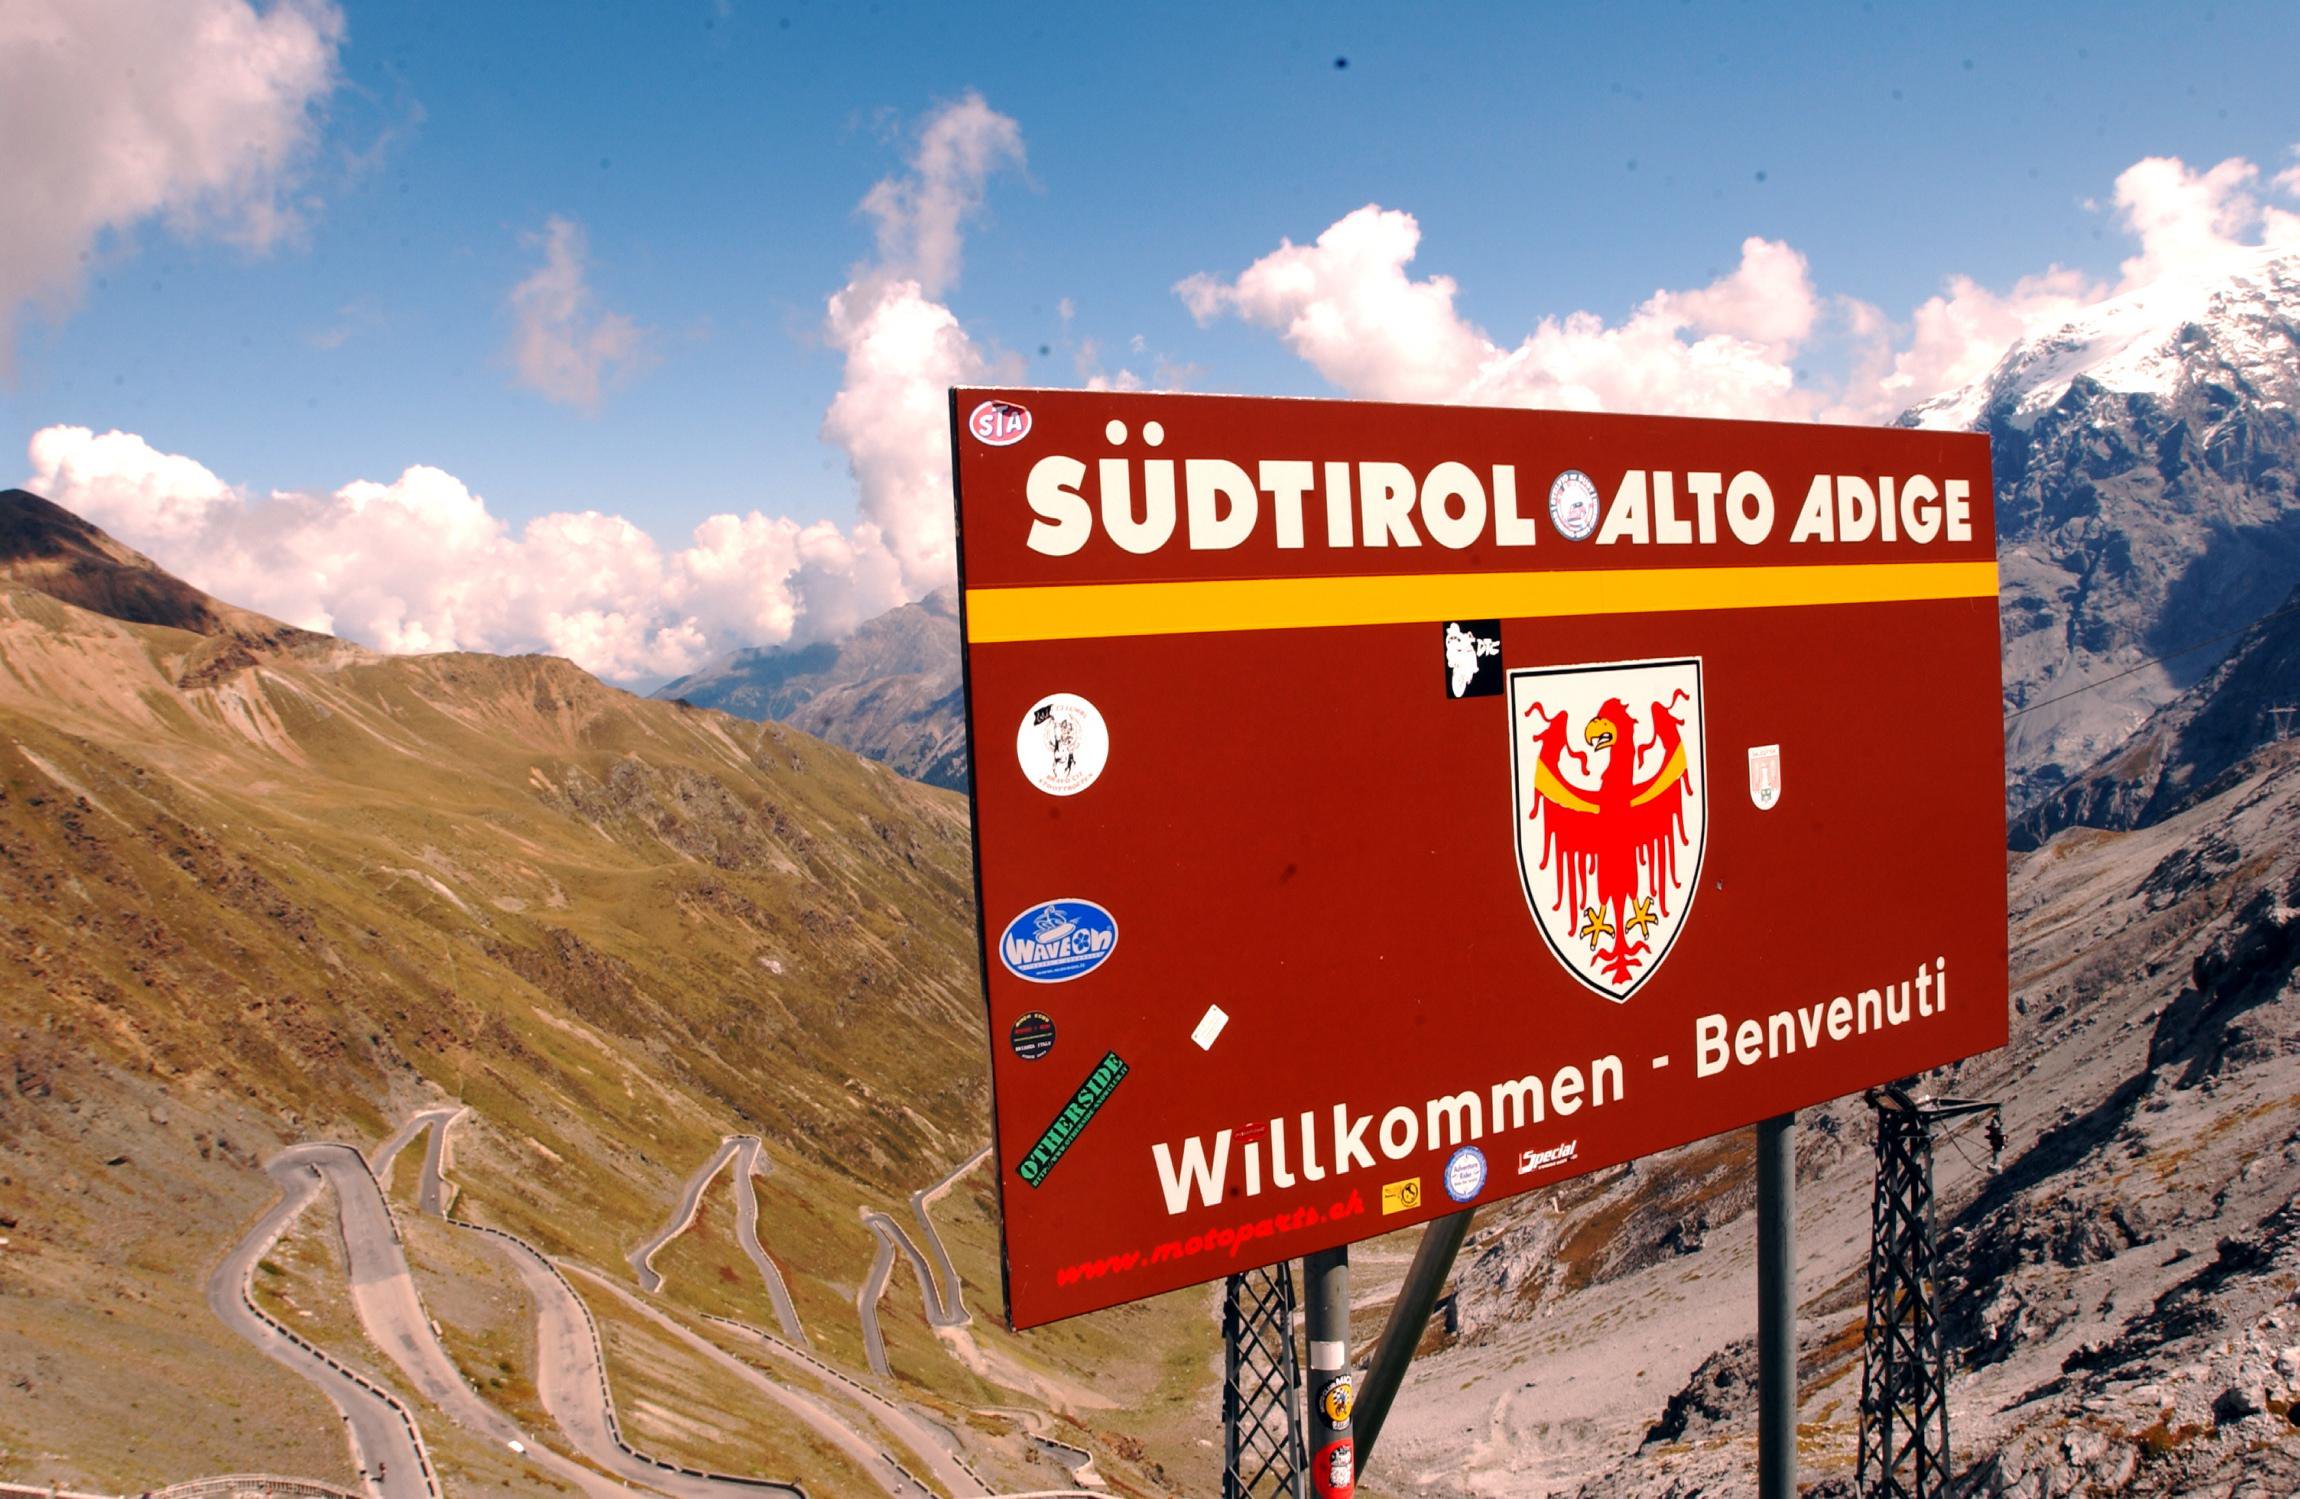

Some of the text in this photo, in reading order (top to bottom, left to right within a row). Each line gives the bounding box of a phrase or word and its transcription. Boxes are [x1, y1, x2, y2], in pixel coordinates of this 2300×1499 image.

[1026, 419, 1536, 557] SÜDTIROL
[1595, 469, 1775, 545] ALTO
[1789, 474, 1973, 544] ADIGE
[1020, 1054, 1124, 1180] OTHERSIDE
[1151, 1054, 1625, 1215] Willkommen
[1696, 956, 1947, 1079] Benvenuti
[1056, 1188, 1365, 1288] www.motoparts.ch
